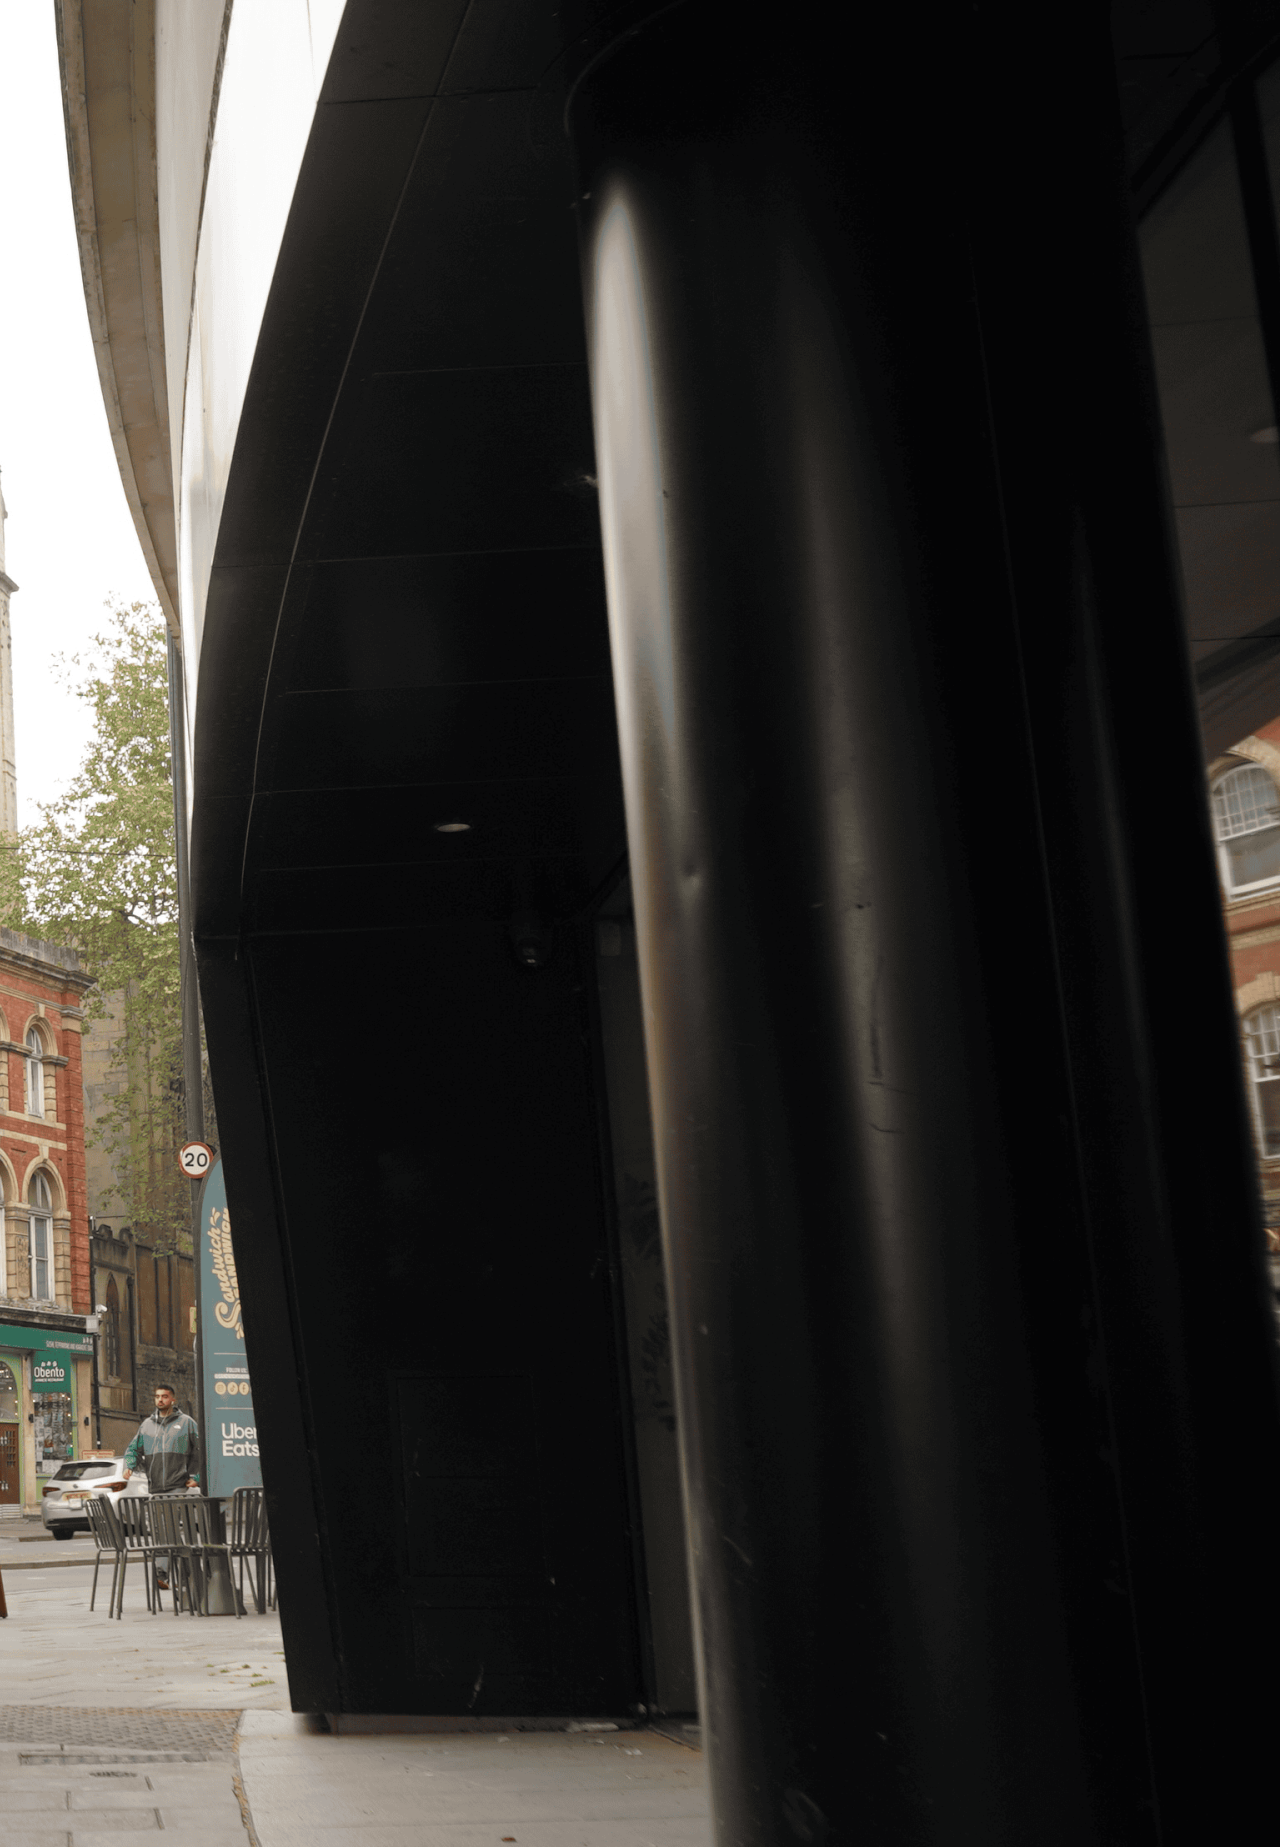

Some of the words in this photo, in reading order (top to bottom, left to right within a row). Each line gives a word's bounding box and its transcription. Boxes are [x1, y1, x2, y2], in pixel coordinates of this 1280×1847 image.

[184, 1153, 208, 1167] 20
[34, 1366, 65, 1378] Obento
[222, 1440, 260, 1457] Eats
